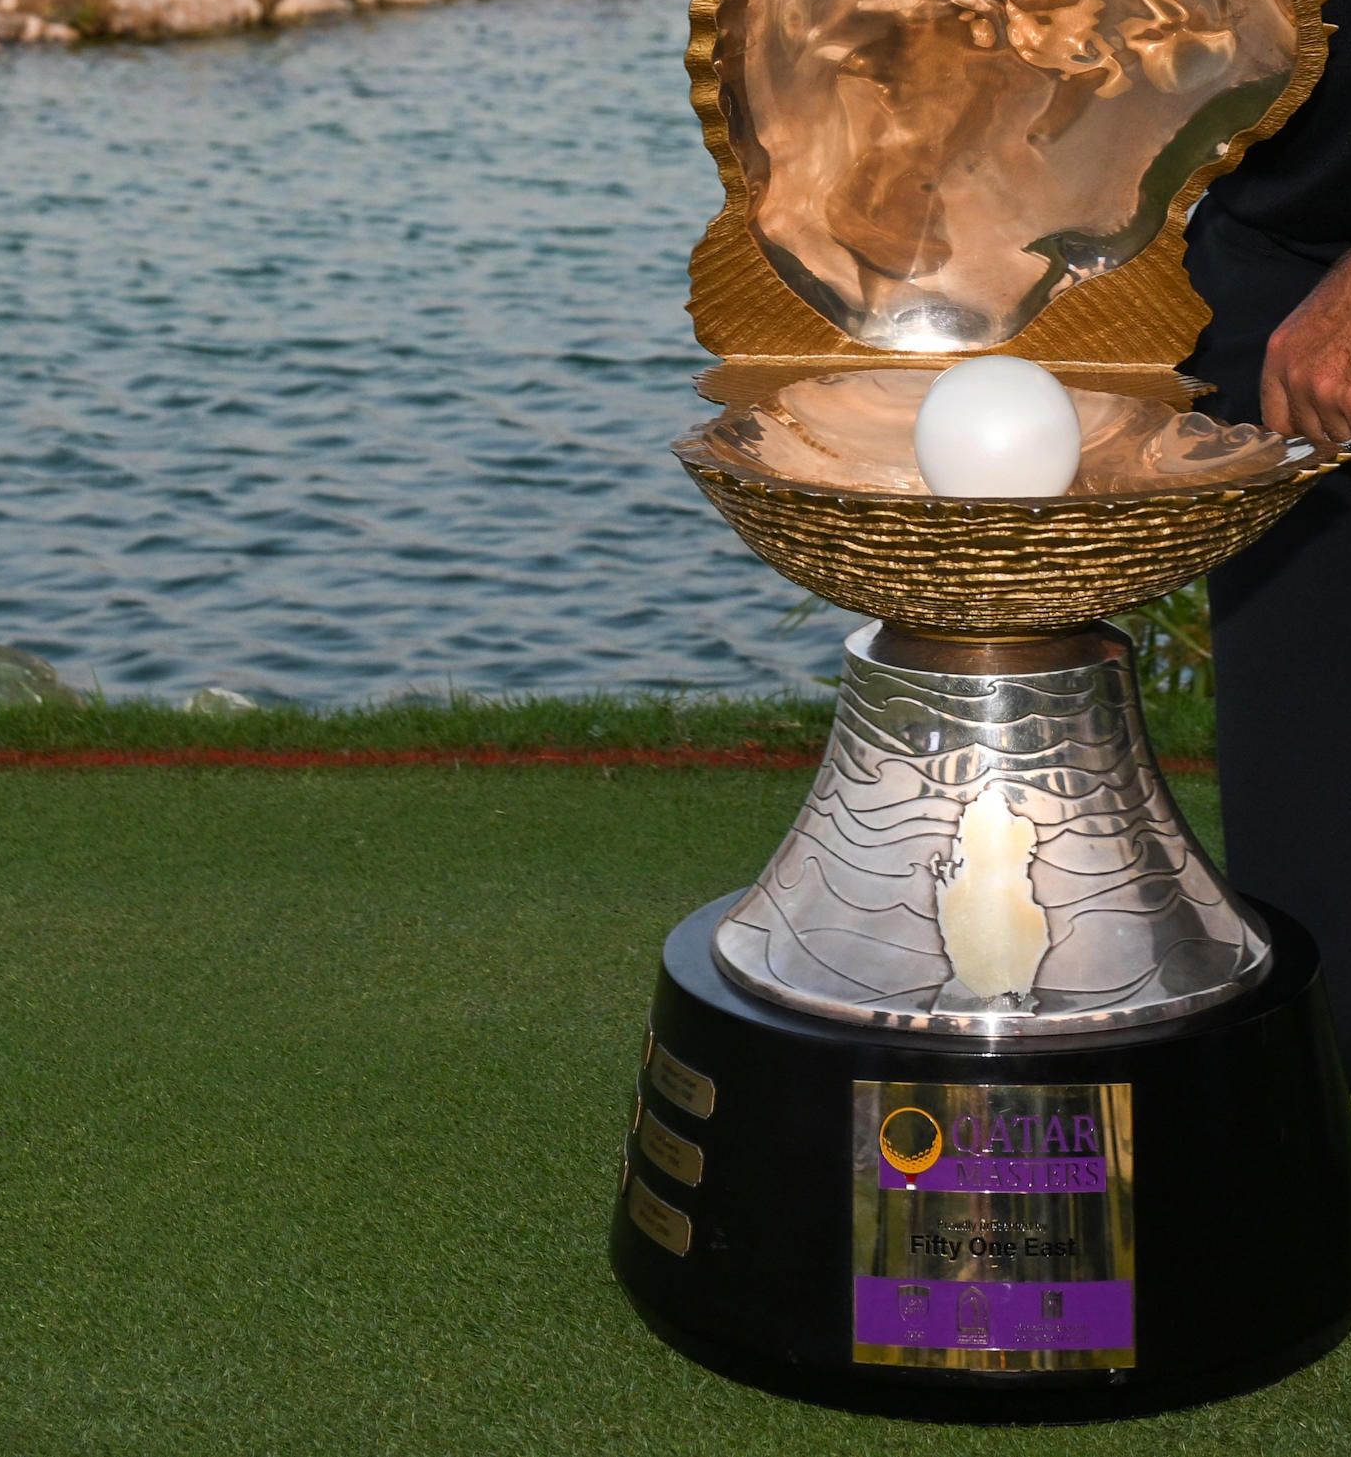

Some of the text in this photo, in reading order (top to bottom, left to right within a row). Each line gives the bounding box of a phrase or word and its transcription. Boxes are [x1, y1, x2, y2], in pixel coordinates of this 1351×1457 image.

[953, 1114, 1099, 1156] QATAR
[956, 1161, 1100, 1187] MASTERS
[910, 1234, 1076, 1261] Fifty One East
